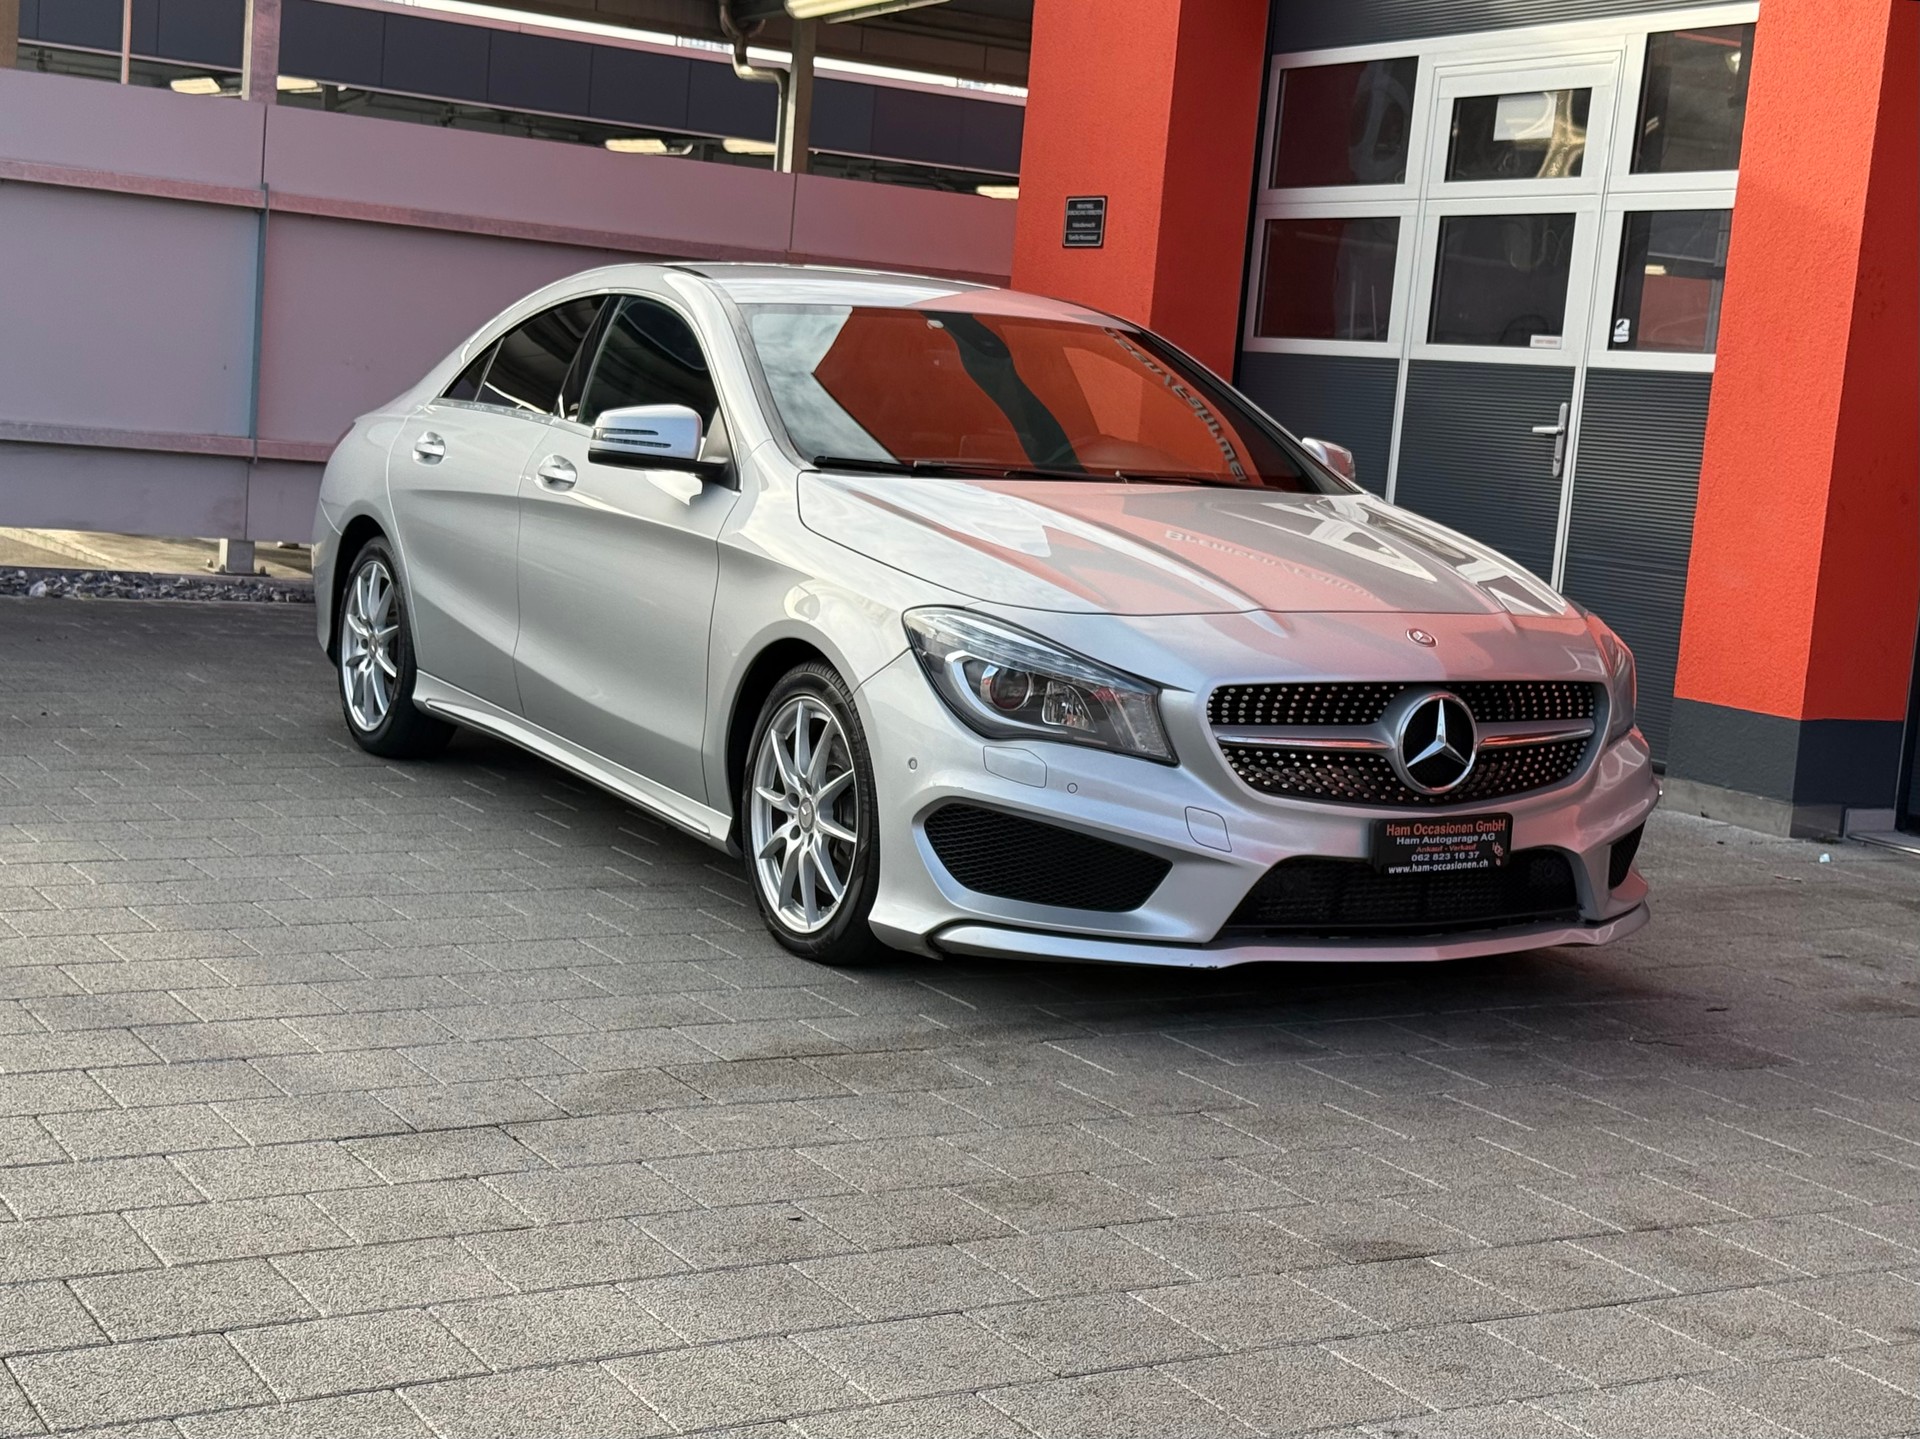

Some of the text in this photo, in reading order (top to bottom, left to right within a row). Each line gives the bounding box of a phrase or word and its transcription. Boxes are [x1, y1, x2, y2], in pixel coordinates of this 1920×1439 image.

[1386, 819, 1506, 837] Ham Occasionen GmbH
[1396, 832, 1496, 845] Ham Autogarage AG
[1411, 851, 1480, 862] 062 823 16 37
[1388, 859, 1489, 874] www.ham-occasionen.ch
